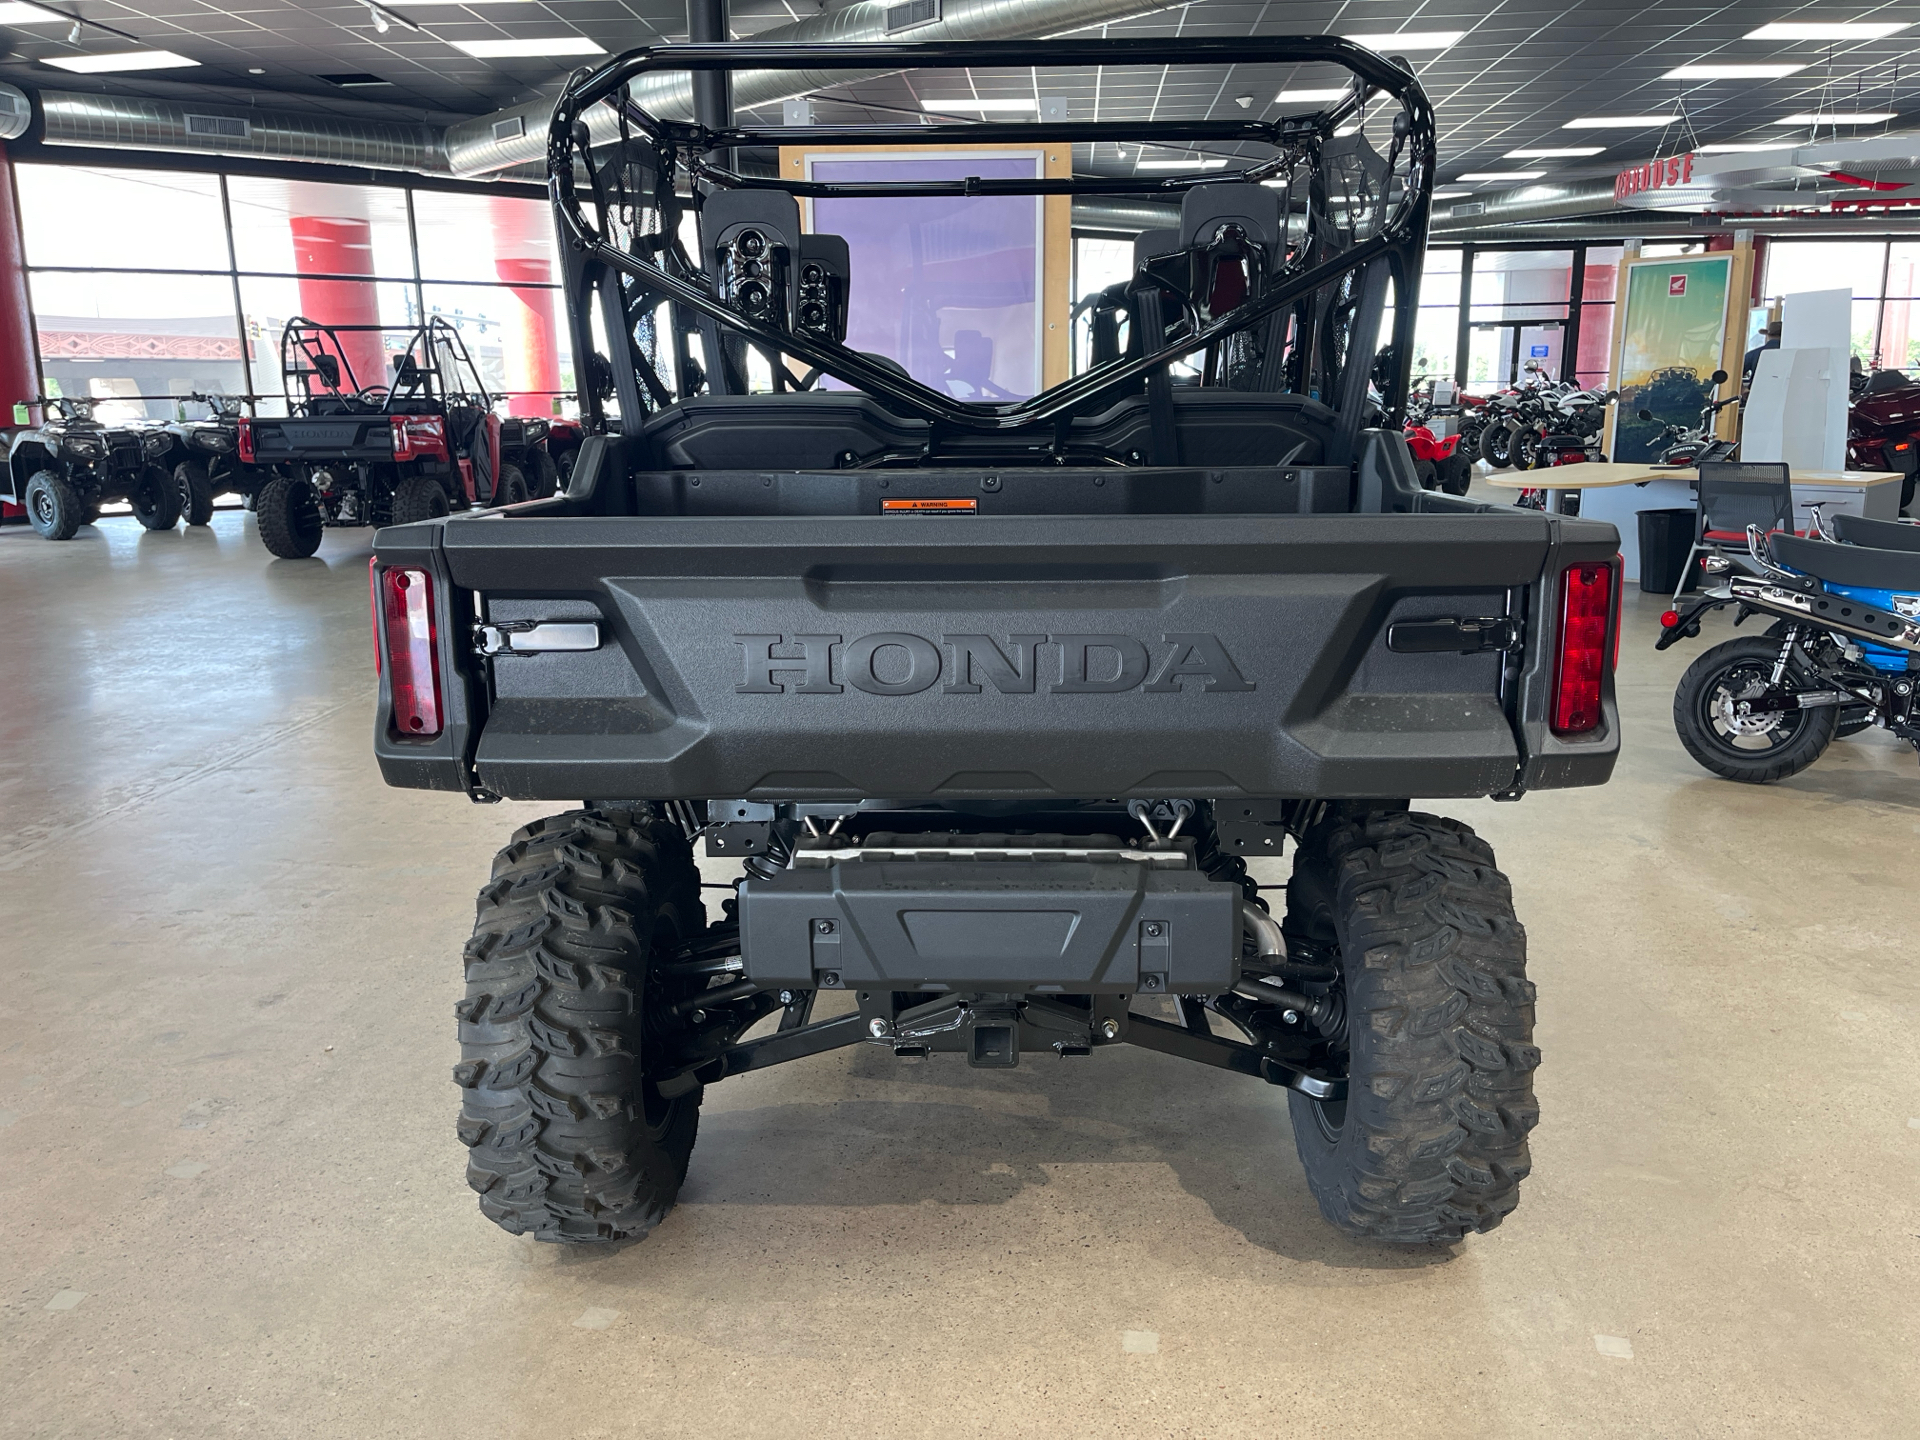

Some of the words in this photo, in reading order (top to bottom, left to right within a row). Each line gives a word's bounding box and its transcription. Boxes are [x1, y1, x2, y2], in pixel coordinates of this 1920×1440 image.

[291, 429, 353, 439] HONDA
[1668, 446, 1697, 456] HONDA
[733, 632, 1256, 696] HONDA
